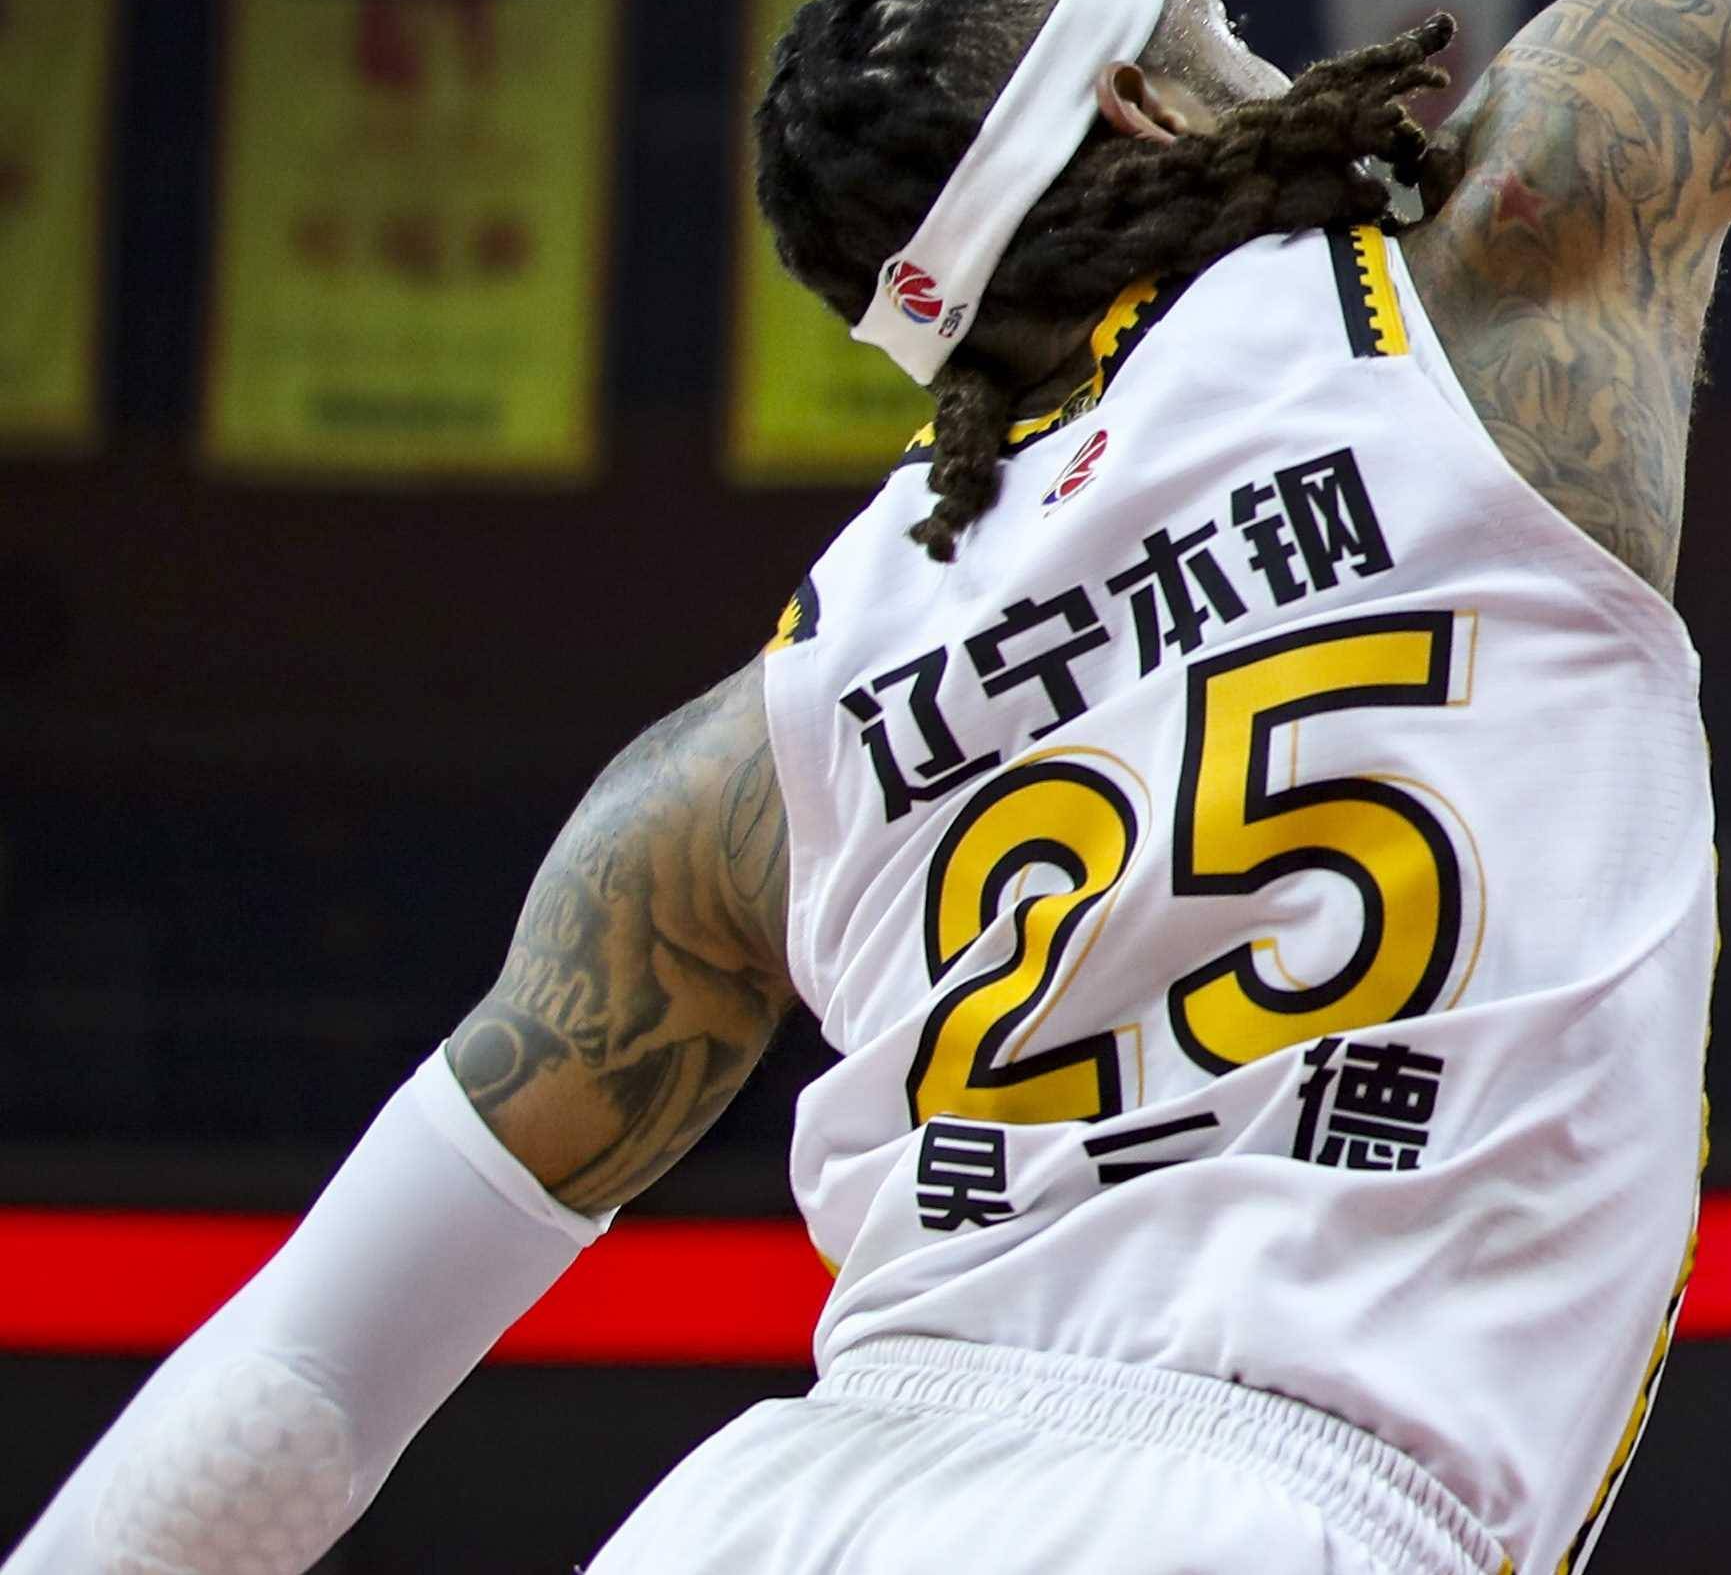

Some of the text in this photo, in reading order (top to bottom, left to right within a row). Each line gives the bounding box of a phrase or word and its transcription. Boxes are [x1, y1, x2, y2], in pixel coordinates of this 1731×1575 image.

[839, 446, 1396, 824] 辽宁本钢
[905, 609, 1480, 1125] 25
